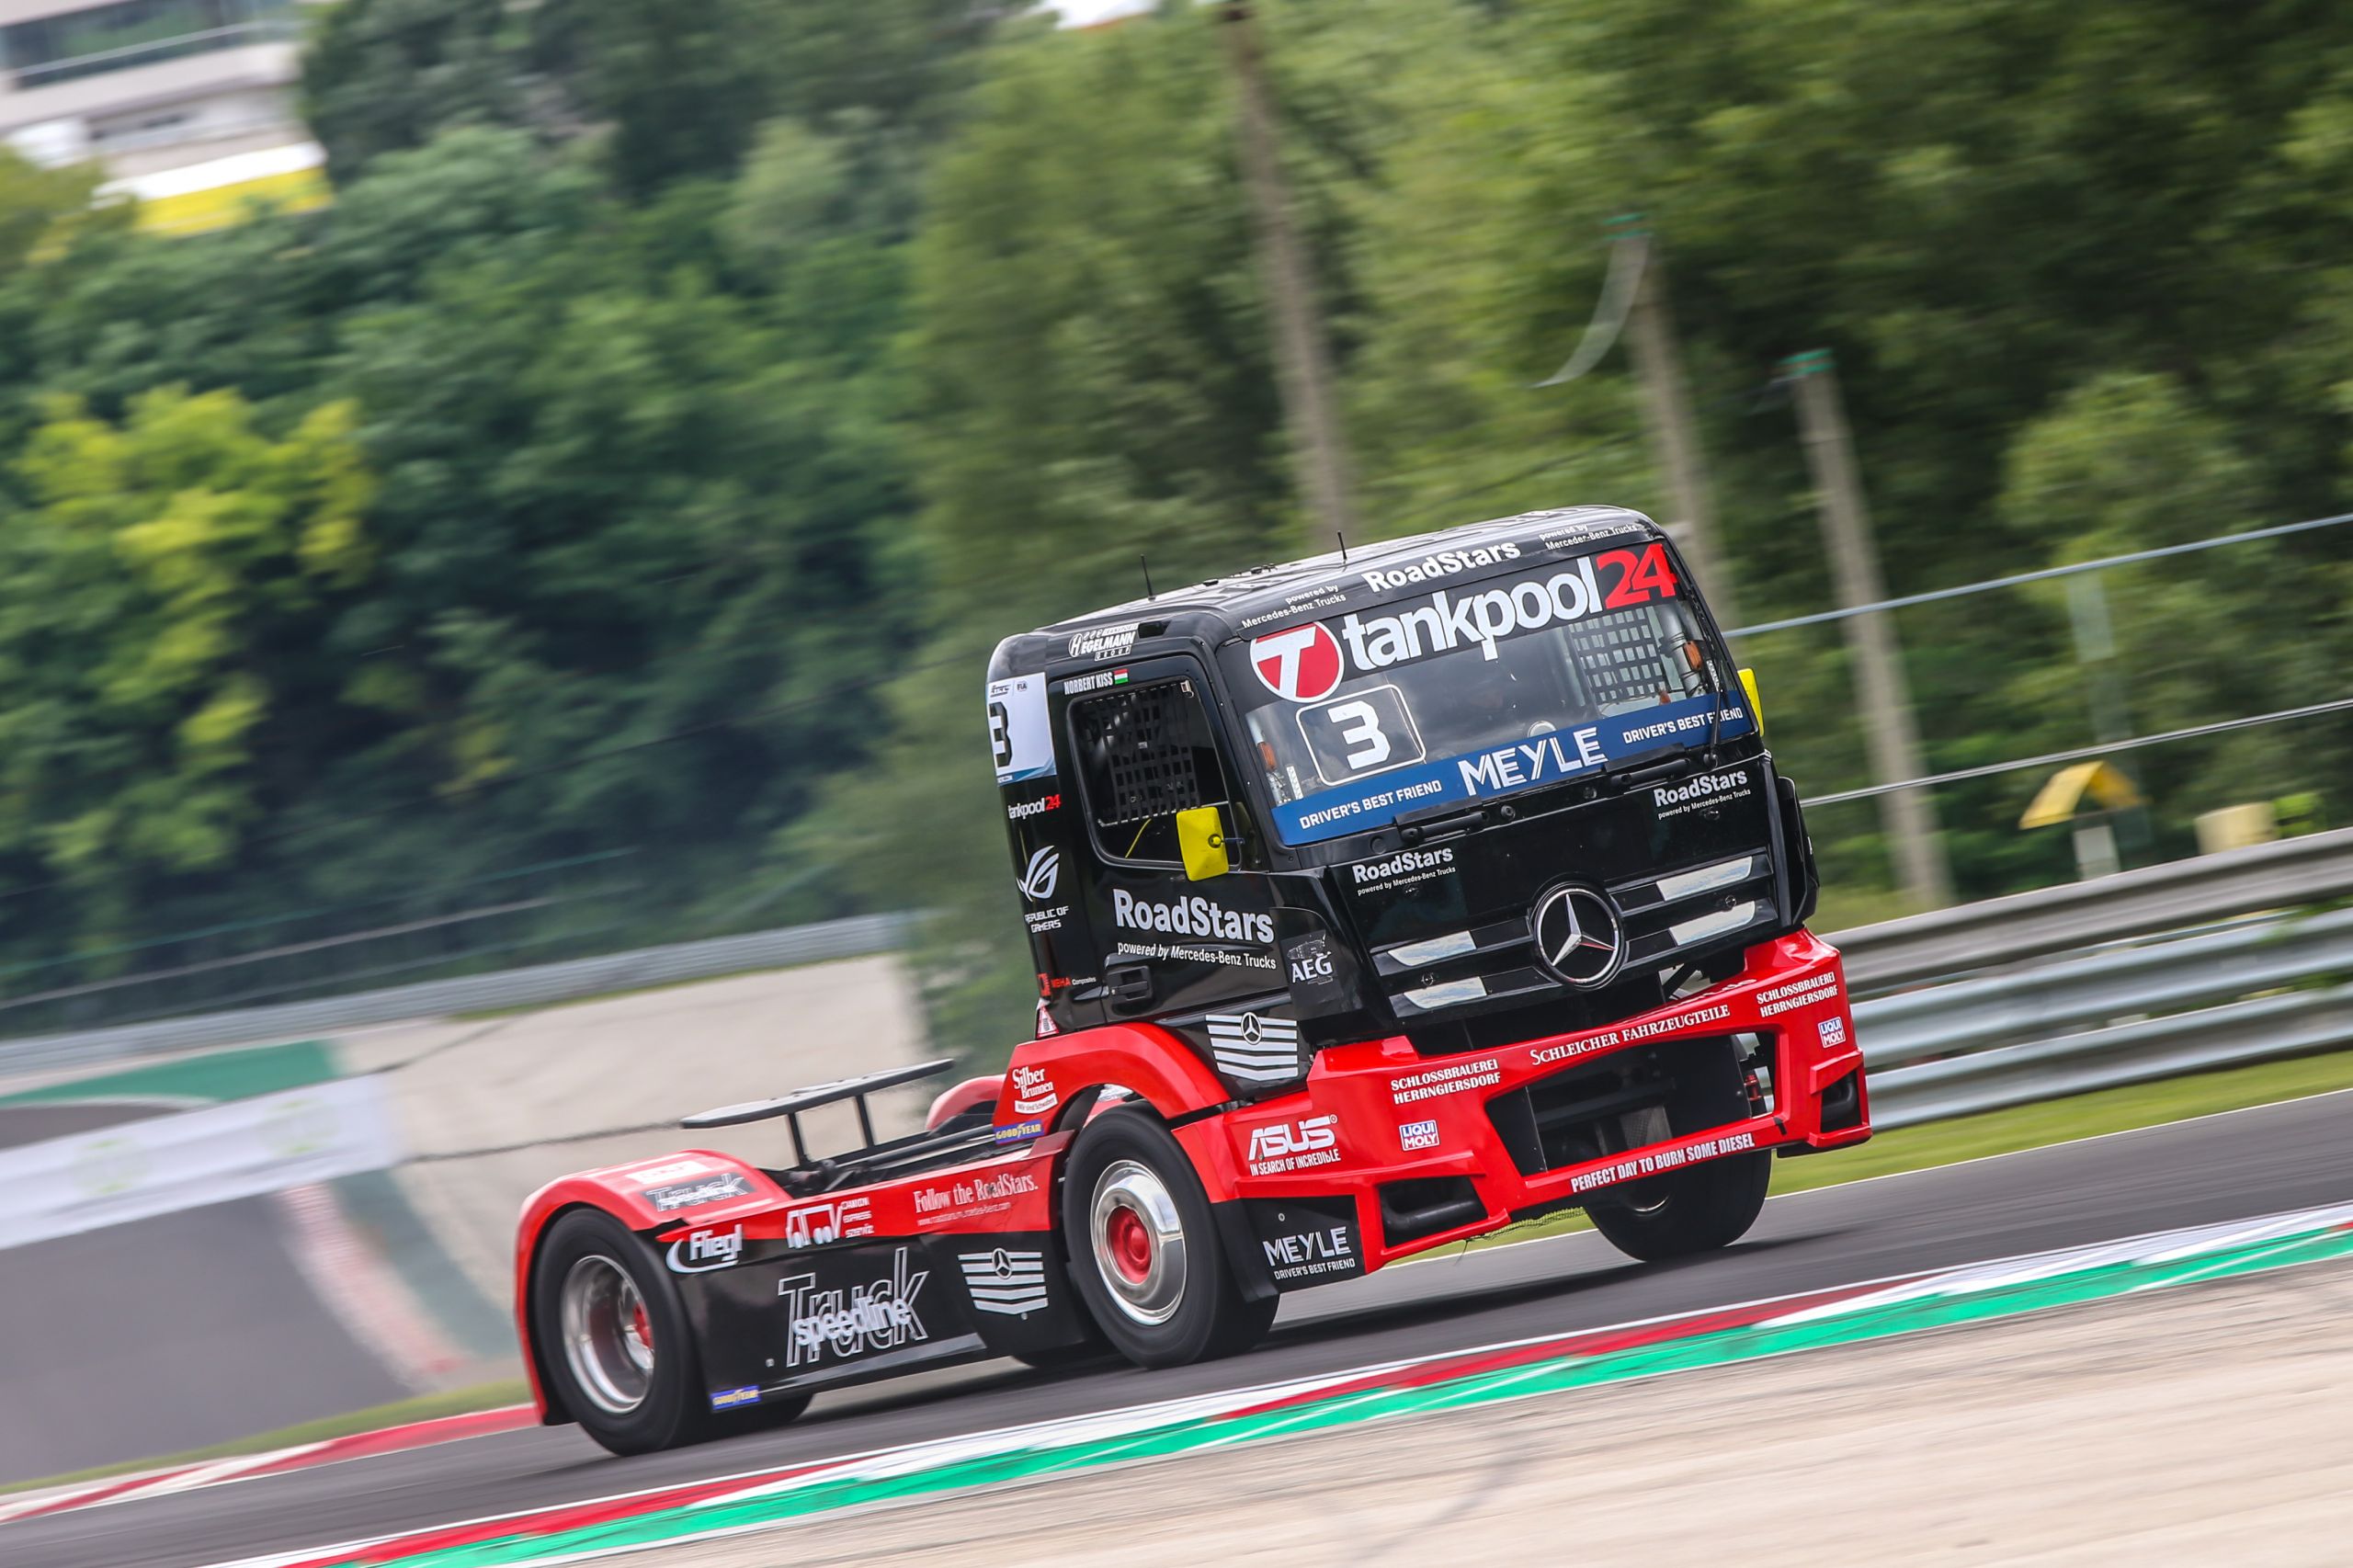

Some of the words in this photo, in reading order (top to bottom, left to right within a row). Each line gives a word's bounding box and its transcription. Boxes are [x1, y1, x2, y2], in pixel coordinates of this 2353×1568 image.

[1539, 525, 1575, 541] powered
[1575, 524, 1588, 532] by
[1610, 524, 1637, 535] Trucks
[1360, 541, 1521, 593] RoadStars
[1286, 586, 1324, 605] powered
[1325, 584, 1339, 596] by
[1342, 543, 1677, 671] tankpool24
[1241, 601, 1313, 629] Mercedes-Benz
[1313, 594, 1347, 608] Trucks
[1069, 631, 1136, 657] HEGELMANN
[1063, 676, 1096, 695] NORBERT
[1096, 672, 1113, 688] KISS
[988, 700, 1013, 767] 3
[1327, 700, 1391, 769] 3
[1622, 721, 1677, 744] DRIVER'S
[1677, 713, 1707, 731] BEST
[1458, 726, 1608, 796] MEYLE
[1299, 801, 1361, 829] DRIVER'S
[1361, 791, 1394, 812] BEST
[1396, 780, 1442, 802] FRIEND
[1654, 771, 1747, 807] RoadStars
[1658, 806, 1683, 820] powered
[1683, 804, 1690, 813] by
[1691, 793, 1733, 810] Mercedes-Benz
[1733, 789, 1751, 799] Trucks
[1352, 847, 1453, 883] RoadStars
[1358, 883, 1383, 896] powered
[1384, 881, 1392, 890] by
[1392, 871, 1436, 887] Mercedes-Benz
[1437, 866, 1456, 876] Trucks
[1056, 905, 1069, 916] OF
[1112, 888, 1275, 944] RoadStars
[1118, 941, 1156, 957] powered
[1158, 944, 1169, 961] by
[1170, 946, 1242, 966] Mercedes-Benz
[1243, 953, 1277, 970] Trucks
[1291, 954, 1333, 983] AEG
[1756, 971, 1836, 1005] SCHLOSSBRAUEREI
[1760, 984, 1838, 1017] HERRNGIERSDORF
[1529, 1032, 1620, 1066] SCHLEICHER
[1622, 1004, 1731, 1042] FAHRZEUGTEILE
[1820, 1019, 1842, 1034] LIQUI
[1823, 1030, 1844, 1045] MOLY
[1012, 1066, 1045, 1089] Silber
[1021, 1082, 1054, 1099] Brunnen
[1391, 1058, 1498, 1091] SCHLOSSBRAUEREI
[1393, 1072, 1501, 1105] HERRNGIERSDORF
[995, 1123, 1041, 1139] GOODYEAR
[1248, 1115, 1336, 1161] ASUS
[1401, 1121, 1436, 1138] LIQUI
[1404, 1133, 1438, 1149] MOLY
[1249, 1164, 1259, 1177] IN
[1259, 1158, 1286, 1176] SEARCH
[1286, 1157, 1295, 1171] OF
[1571, 1167, 1617, 1193] PERFECT
[1617, 1161, 1639, 1179] DAY
[1639, 1157, 1654, 1174] TO
[1654, 1151, 1687, 1170] BURN
[1687, 1142, 1718, 1162] SOME
[1719, 1132, 1755, 1154] DIESEL
[914, 1188, 951, 1213] Follow
[953, 1183, 974, 1206] the
[973, 1173, 1039, 1200] RoadStars.
[689, 1223, 743, 1261] Fliegl
[1262, 1225, 1352, 1267] MEYLE
[1273, 1266, 1309, 1280] DRIVER'S
[1309, 1263, 1327, 1274] BEST
[1327, 1257, 1356, 1272] FRIEND
[779, 1246, 929, 1369] Truck
[792, 1295, 912, 1352] speedline
